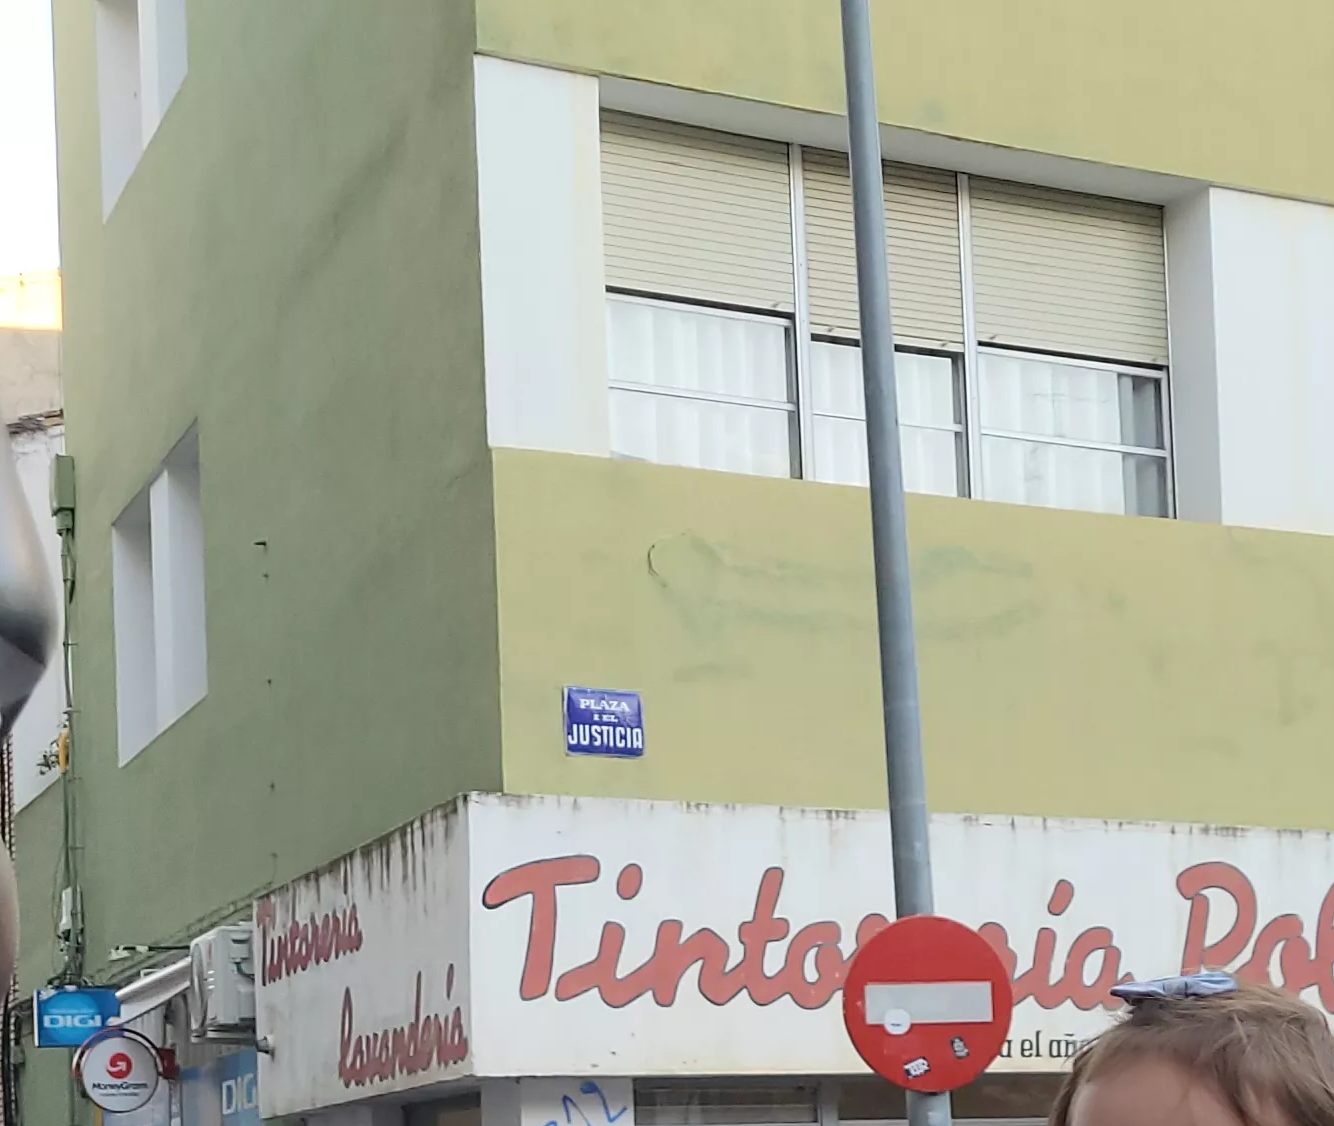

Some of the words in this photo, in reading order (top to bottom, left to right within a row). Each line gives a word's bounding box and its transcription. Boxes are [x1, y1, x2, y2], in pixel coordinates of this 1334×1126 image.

[578, 698, 630, 712] PLAZA
[567, 723, 643, 749] JUSTICIA
[482, 854, 1135, 1012] Tintoía
[43, 1014, 103, 1028] DIGI
[1021, 1030, 1044, 1058] el
[92, 1080, 149, 1092] MoneyGram
[222, 1072, 258, 1115] DIG
